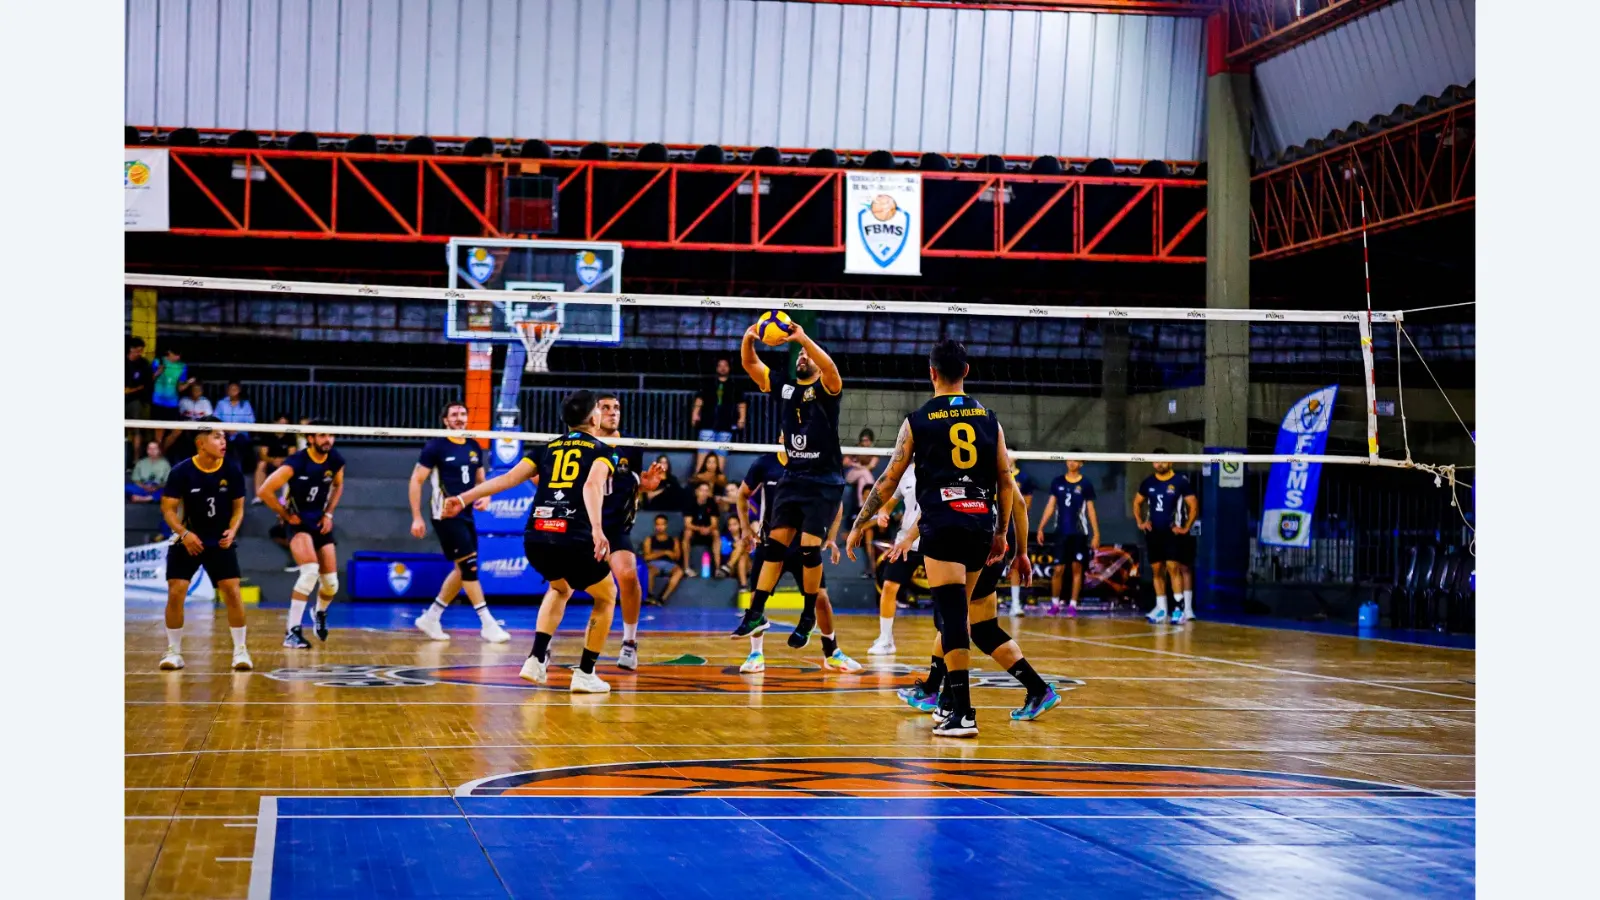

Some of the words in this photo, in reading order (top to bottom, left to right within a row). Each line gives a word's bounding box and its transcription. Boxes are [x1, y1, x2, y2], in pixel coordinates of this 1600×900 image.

[864, 224, 903, 236] FBMS
[928, 409, 949, 420] UNIÃO
[950, 409, 959, 417] CG
[949, 422, 978, 469] 8
[460, 465, 470, 484] 8
[551, 448, 582, 482] 16
[306, 486, 319, 502] 9
[206, 496, 216, 518] 3
